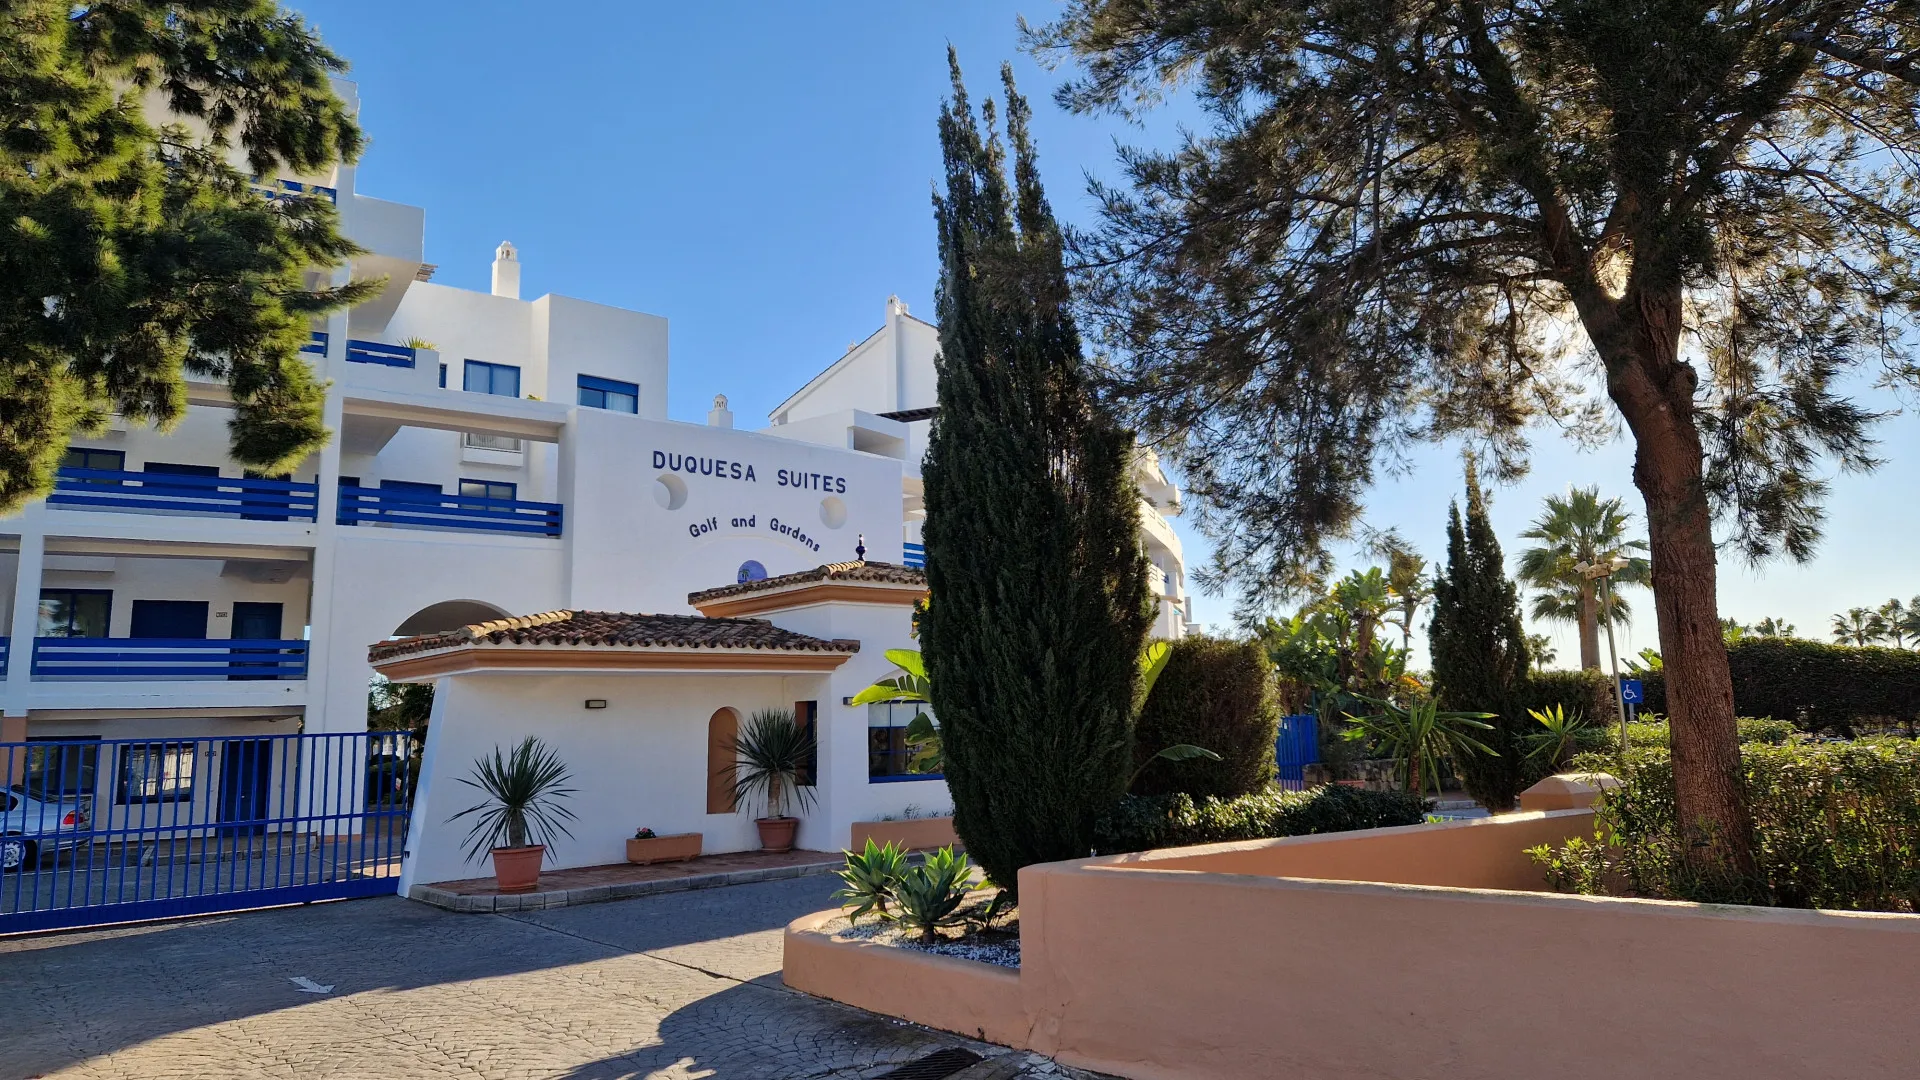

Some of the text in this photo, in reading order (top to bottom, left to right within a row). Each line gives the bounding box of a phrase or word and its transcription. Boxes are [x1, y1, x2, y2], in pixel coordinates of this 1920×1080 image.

[652, 450, 846, 494] DUQUESA SUITES
[688, 514, 820, 552] Golf and Gardens
